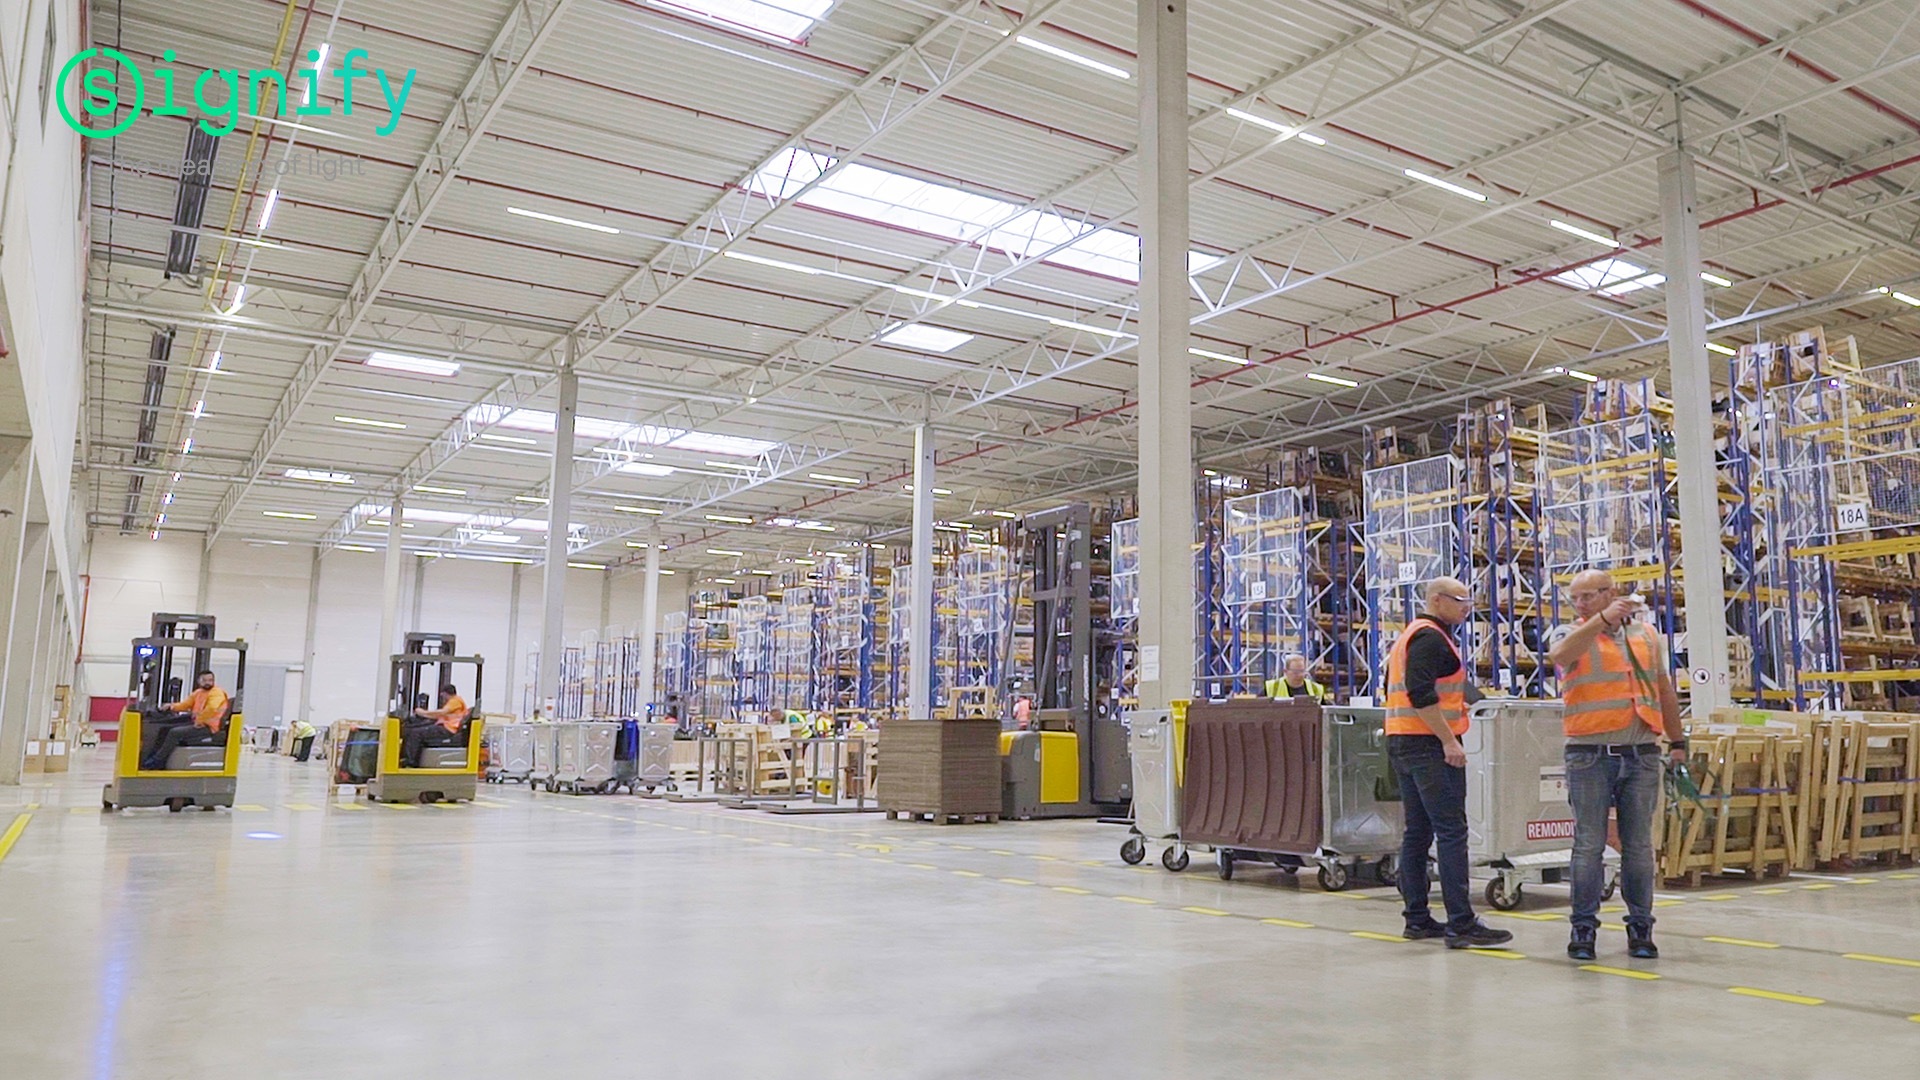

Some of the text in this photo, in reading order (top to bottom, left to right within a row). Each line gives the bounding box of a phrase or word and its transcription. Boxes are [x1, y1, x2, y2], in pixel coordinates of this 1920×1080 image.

[1840, 507, 1865, 524] 18A
[1588, 541, 1607, 556] 17A
[1527, 821, 1575, 839] REMONDI
